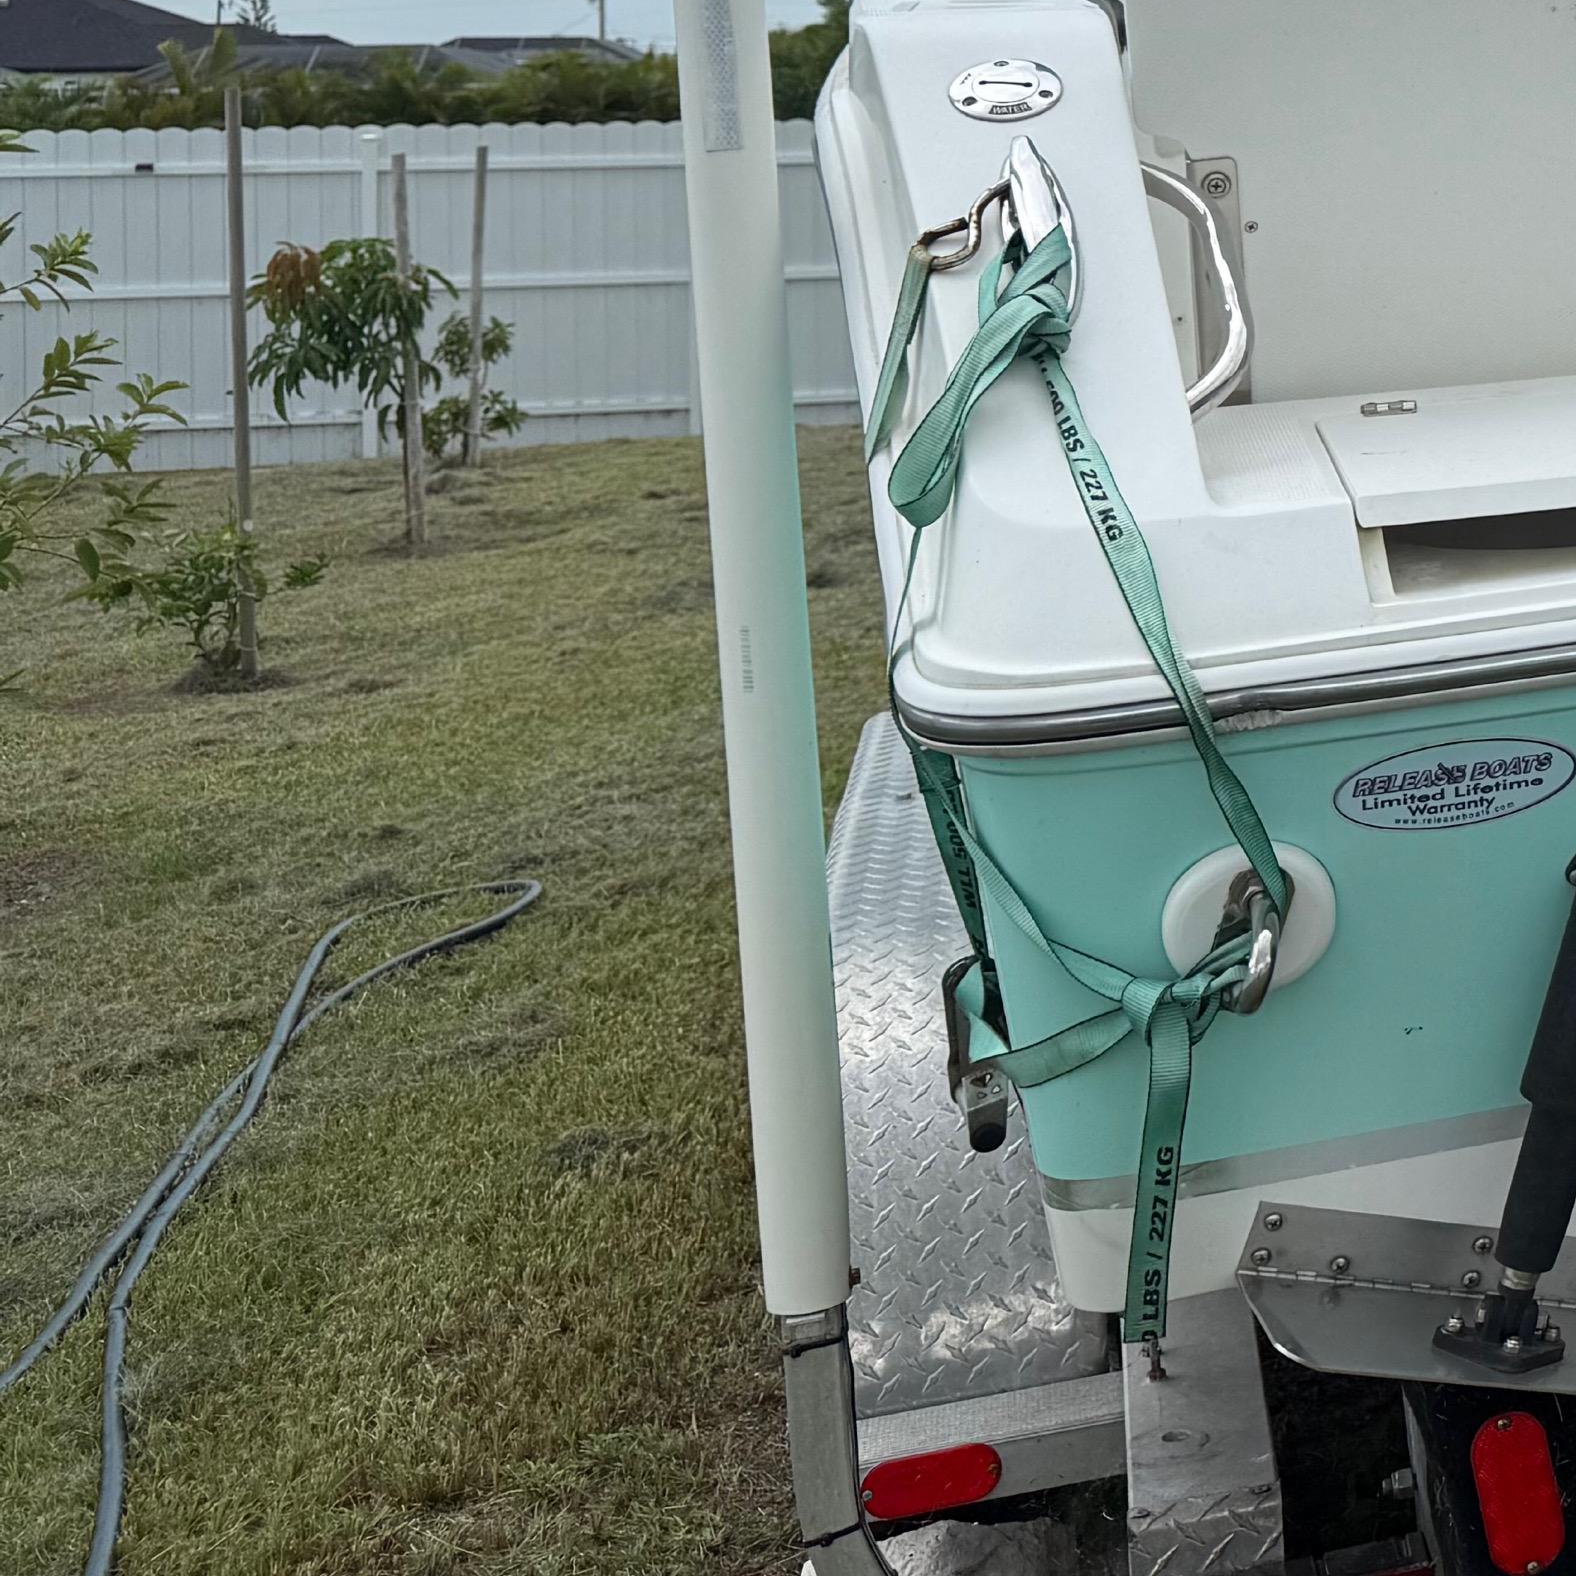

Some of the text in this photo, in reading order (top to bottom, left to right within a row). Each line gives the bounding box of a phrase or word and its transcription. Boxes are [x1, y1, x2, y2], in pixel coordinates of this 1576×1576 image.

[991, 103, 1030, 115] WATER
[1057, 415, 1085, 453] LBS
[1079, 468, 1109, 502] 227
[1097, 507, 1125, 542] KG
[1352, 752, 1553, 798] RELEASE BOATS
[1362, 777, 1544, 812] Limited Lifetime
[1394, 801, 1516, 825] www.releaseboats.com
[1407, 795, 1497, 817] Warranty
[960, 866, 978, 909] WLL
[1155, 1145, 1174, 1187] KG
[1149, 1195, 1169, 1242] 227
[1142, 1269, 1162, 1321] LBS
